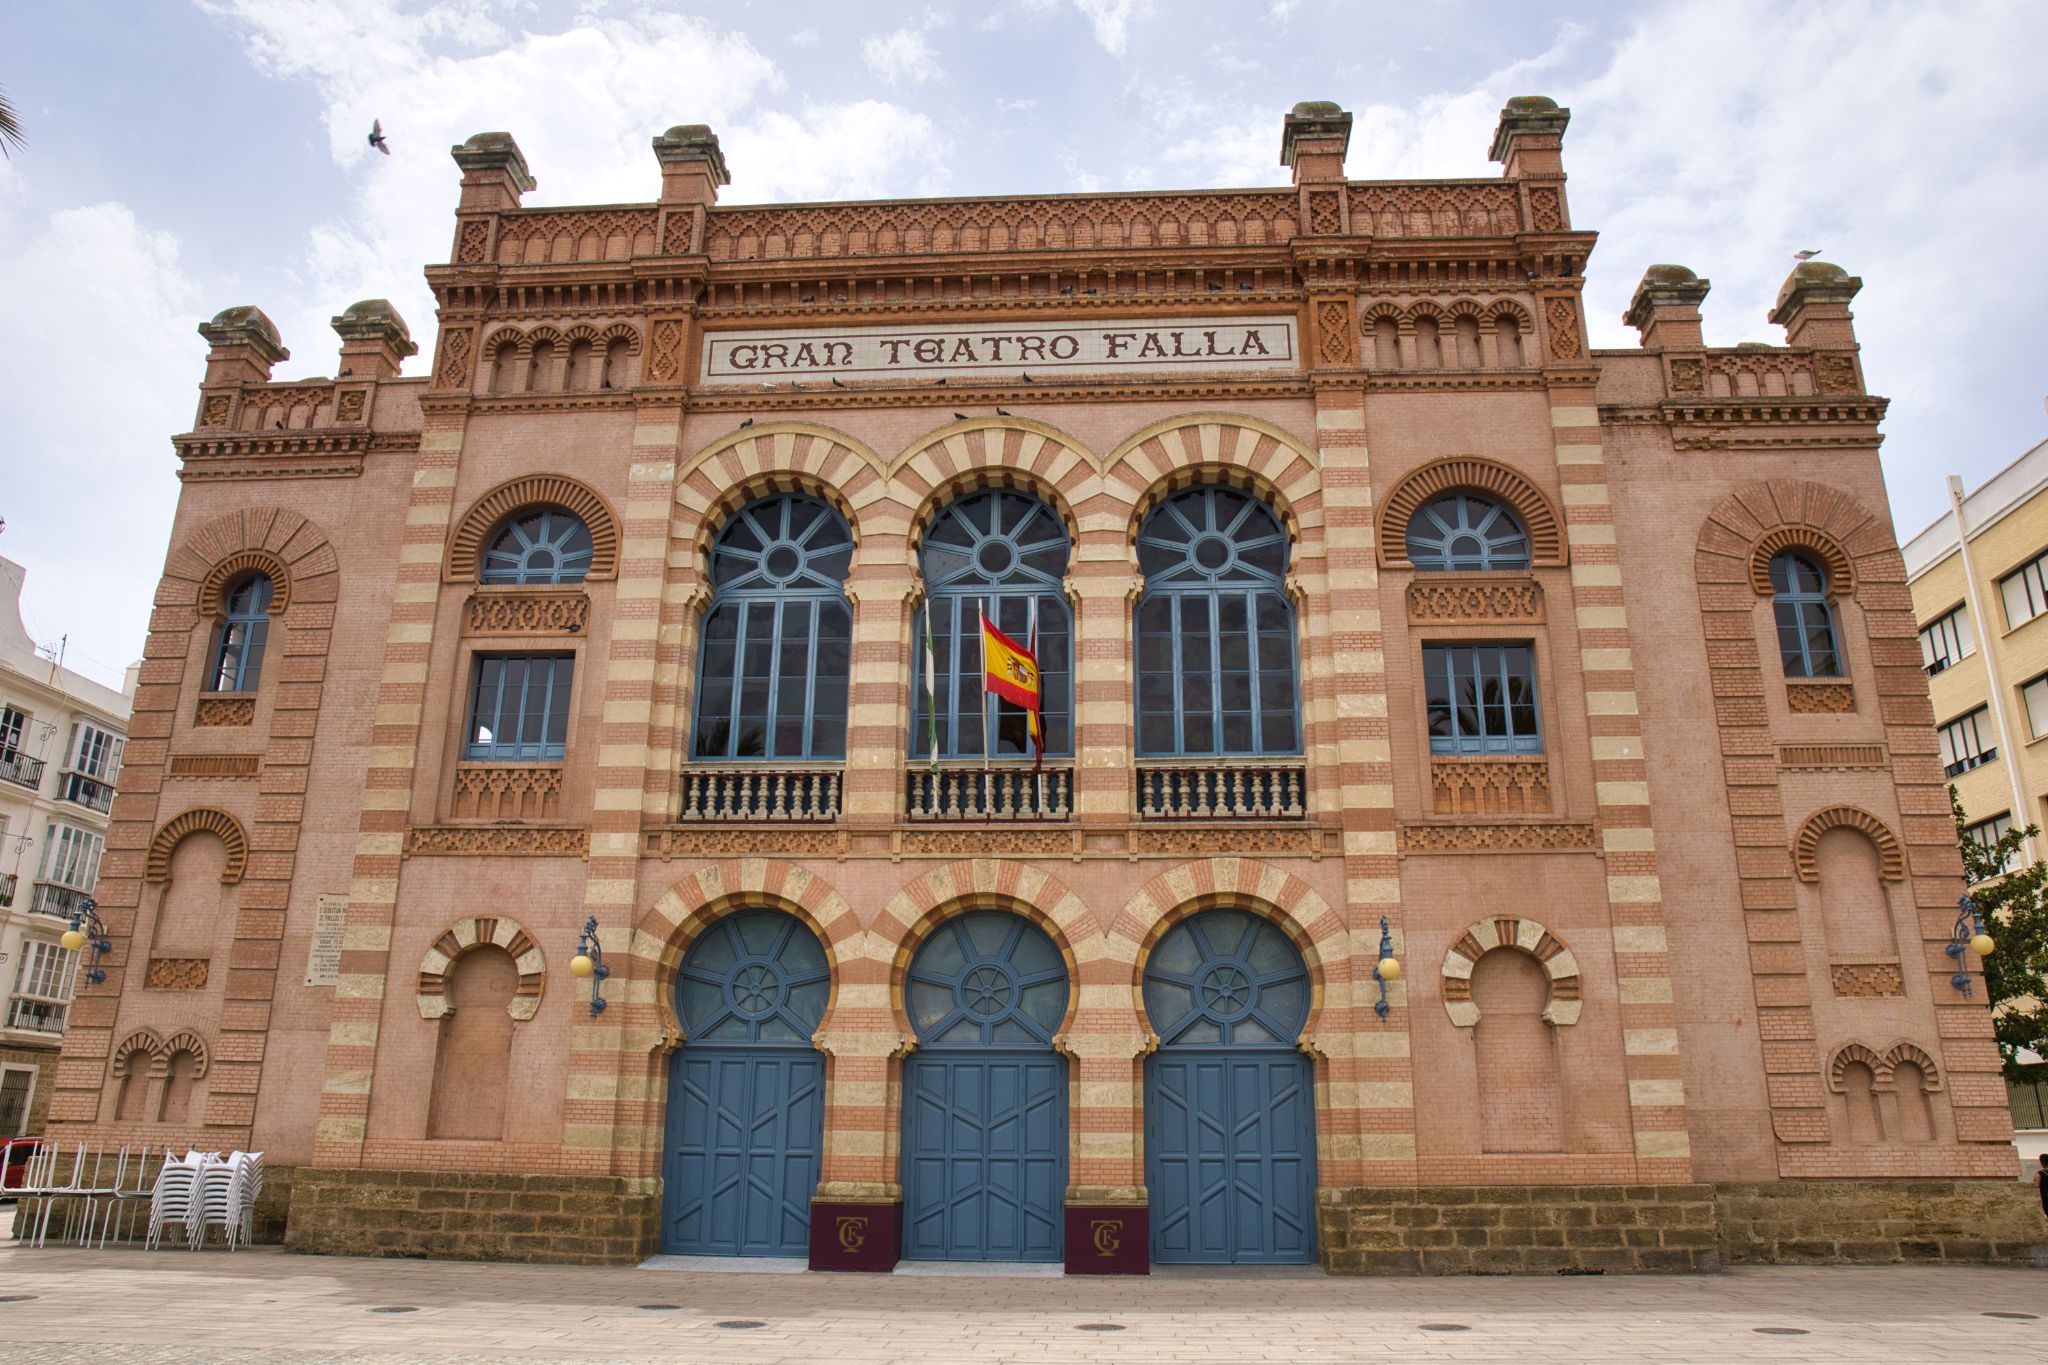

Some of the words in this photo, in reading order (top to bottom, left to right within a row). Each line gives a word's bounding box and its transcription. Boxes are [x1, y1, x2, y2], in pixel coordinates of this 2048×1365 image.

[728, 341, 854, 370] GRAN
[879, 334, 1081, 364] TEATRO
[1102, 329, 1270, 359] FALLA
